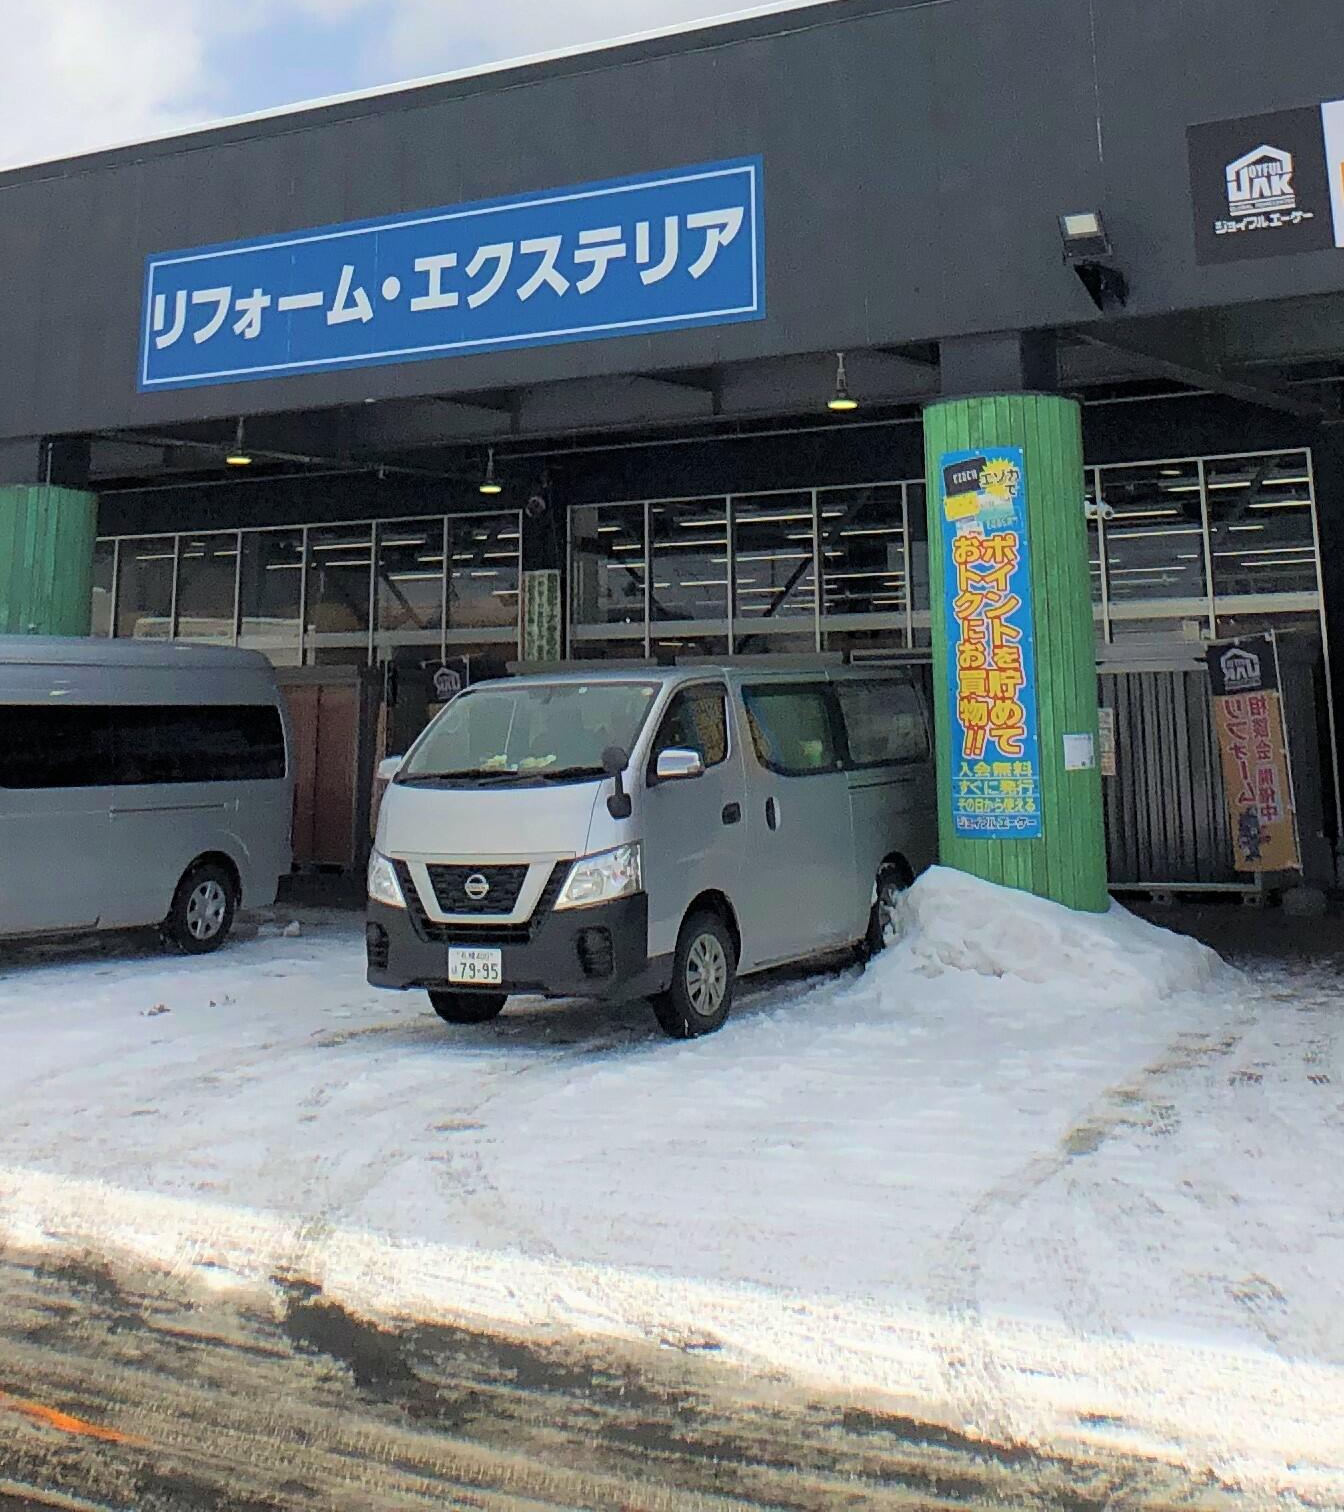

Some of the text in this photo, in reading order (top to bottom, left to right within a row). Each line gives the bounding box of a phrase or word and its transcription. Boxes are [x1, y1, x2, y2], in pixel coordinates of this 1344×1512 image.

[152, 206, 744, 350] リフォーム・エクステリア
[981, 533, 1025, 756] ポイントを貯めて
[959, 761, 1033, 777] 入会無料
